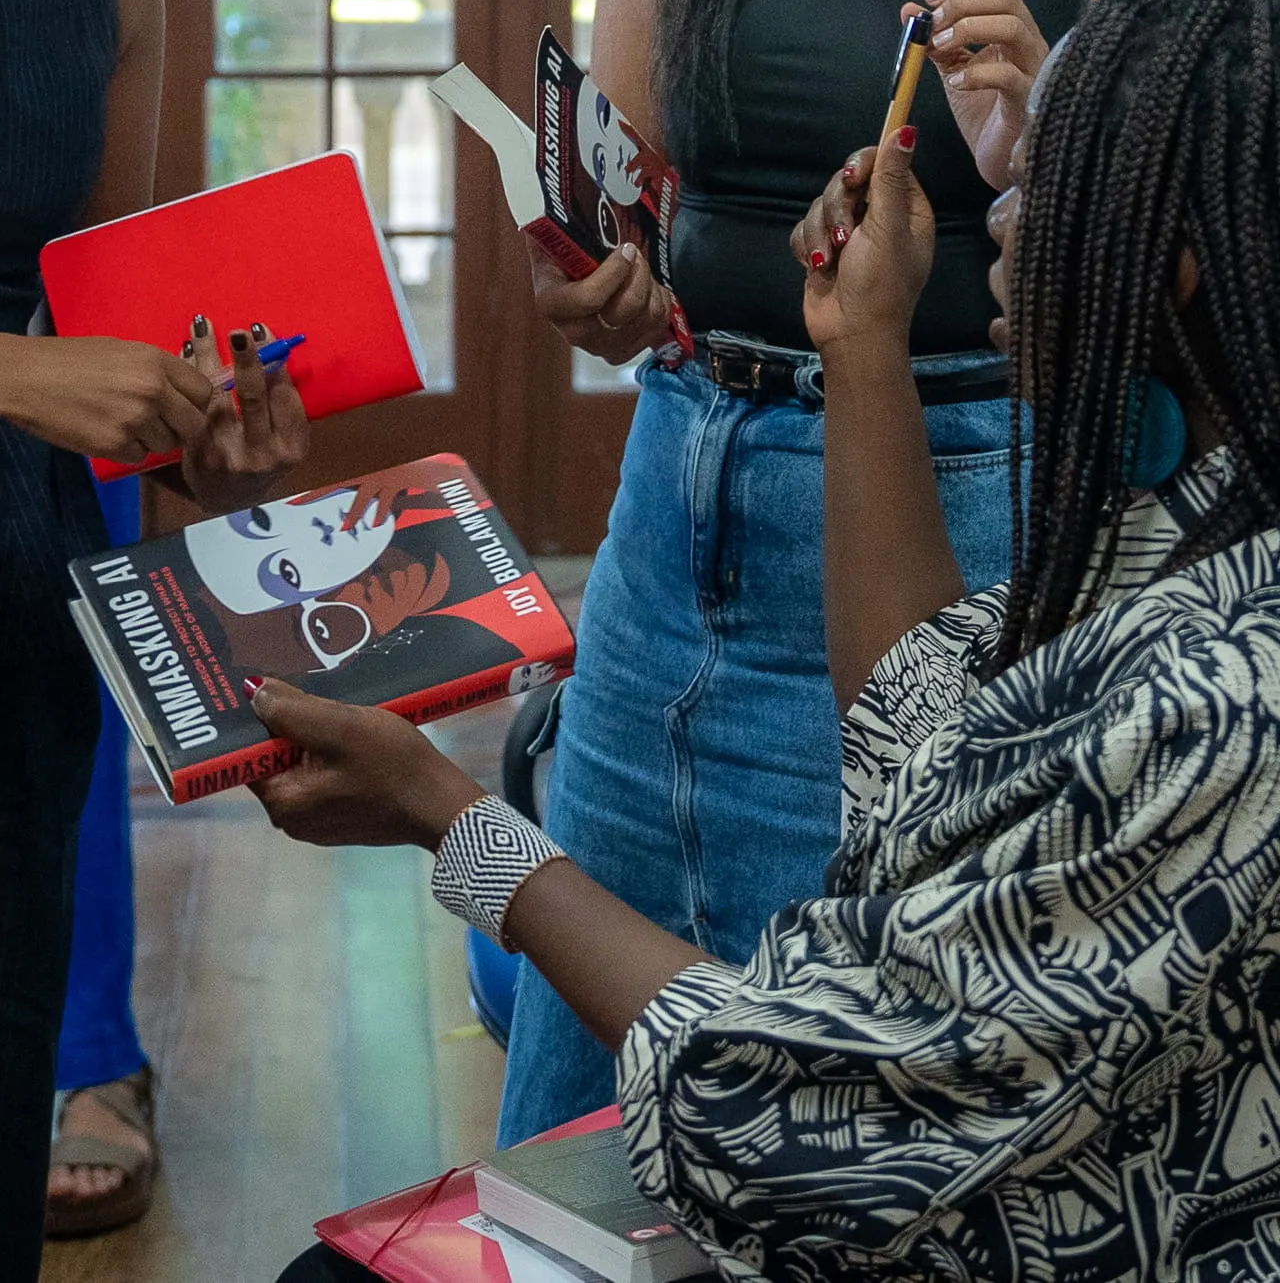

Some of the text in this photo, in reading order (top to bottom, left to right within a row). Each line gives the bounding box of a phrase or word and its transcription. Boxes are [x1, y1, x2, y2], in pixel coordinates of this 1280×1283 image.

[547, 46, 563, 80] AI
[545, 80, 568, 224] UNMASKING
[658, 176, 672, 279] BUOLAMWINI
[436, 478, 543, 617] JOY BUOLAMWINI
[153, 581, 171, 606] WHAT
[160, 566, 189, 610] MACHINES
[166, 608, 191, 644] PROTECT
[184, 612, 195, 623] OF
[91, 555, 218, 750] UNMASKING AI
[186, 645, 197, 657] TO
[190, 624, 212, 655] WORLD
[193, 658, 218, 697] MISSION
[212, 663, 222, 675] IN
[213, 697, 226, 711] MY
[217, 675, 239, 709] HUMAN
